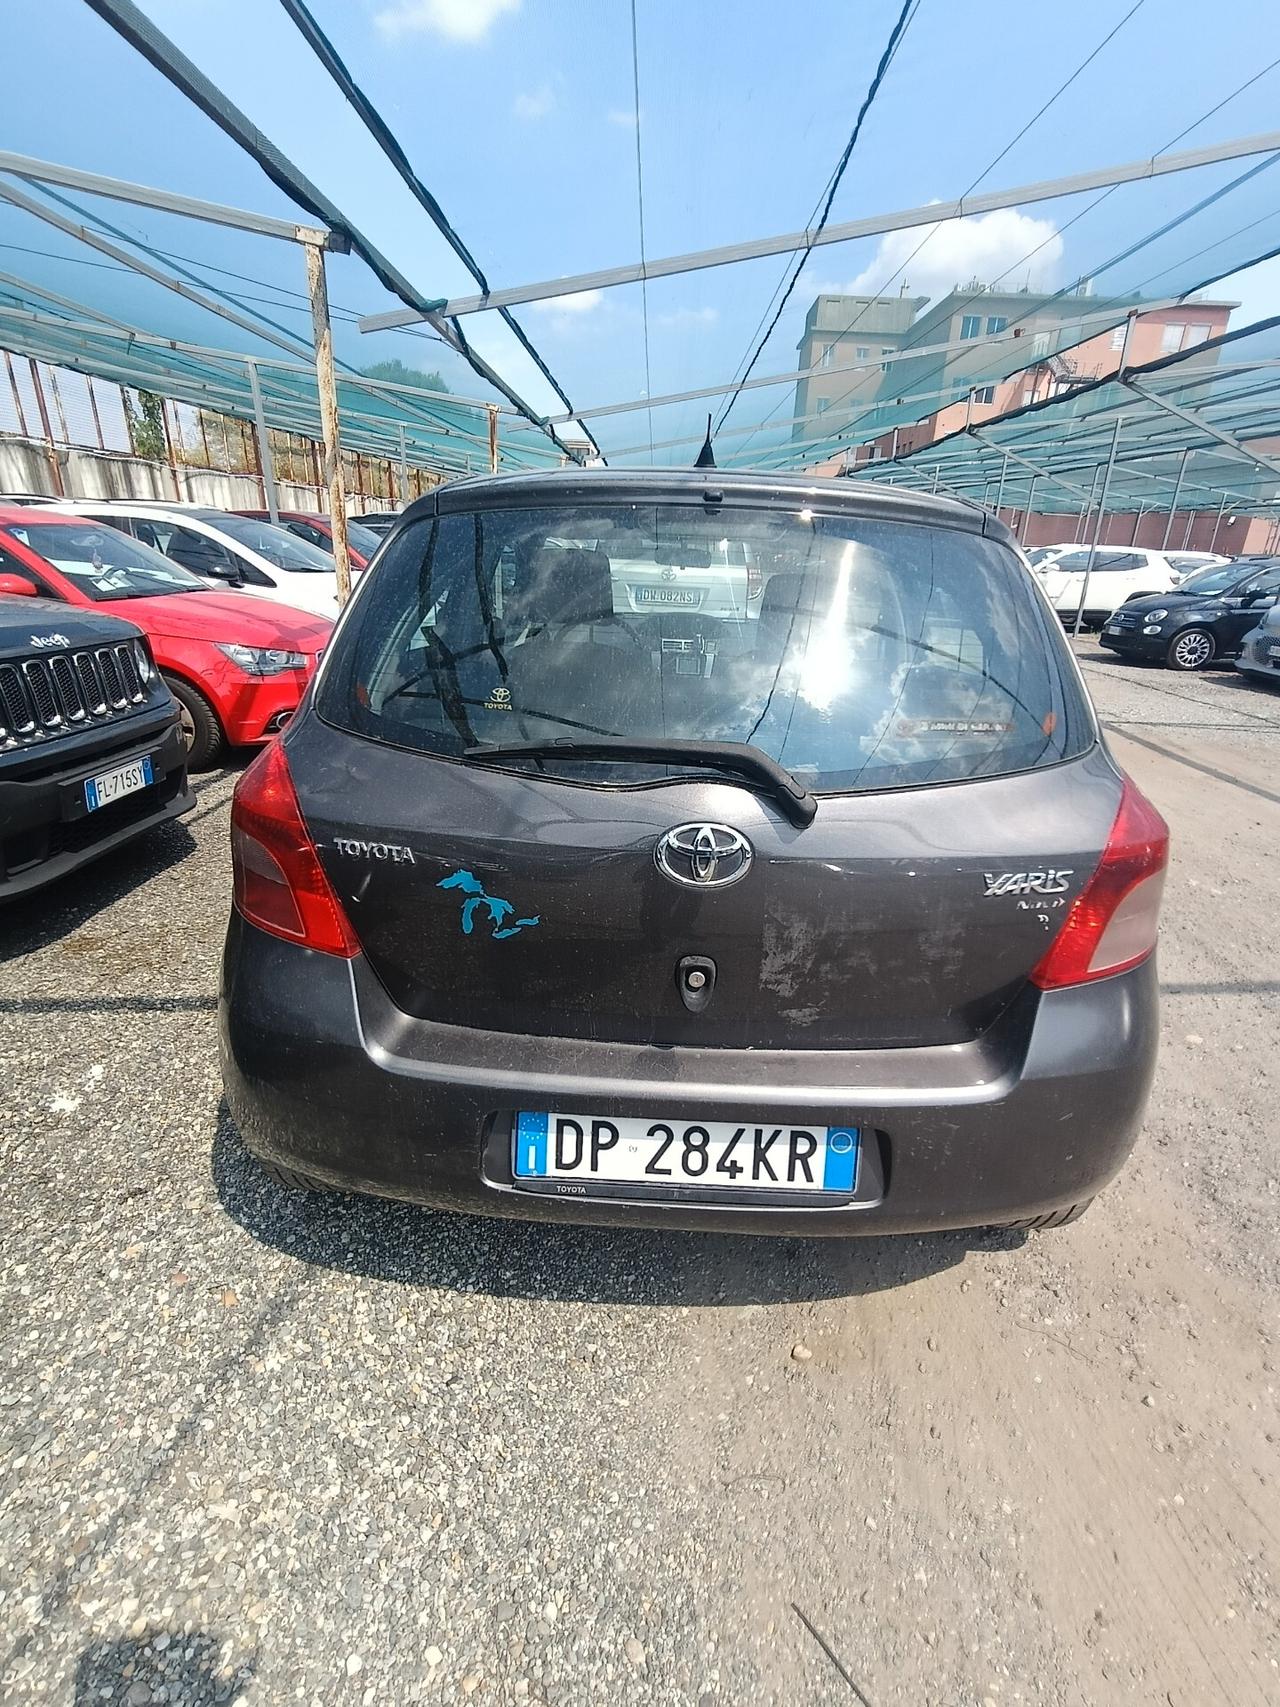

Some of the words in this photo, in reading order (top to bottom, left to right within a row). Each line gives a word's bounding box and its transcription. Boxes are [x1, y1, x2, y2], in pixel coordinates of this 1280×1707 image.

[30, 633, 70, 648] Jeep
[483, 702, 512, 711] TOYOTA
[333, 837, 416, 864] TOYOTA
[528, 1145, 536, 1170] I
[555, 1118, 620, 1172] DP
[645, 1123, 817, 1183] 284KR
[556, 1184, 587, 1194] TOYOTA
